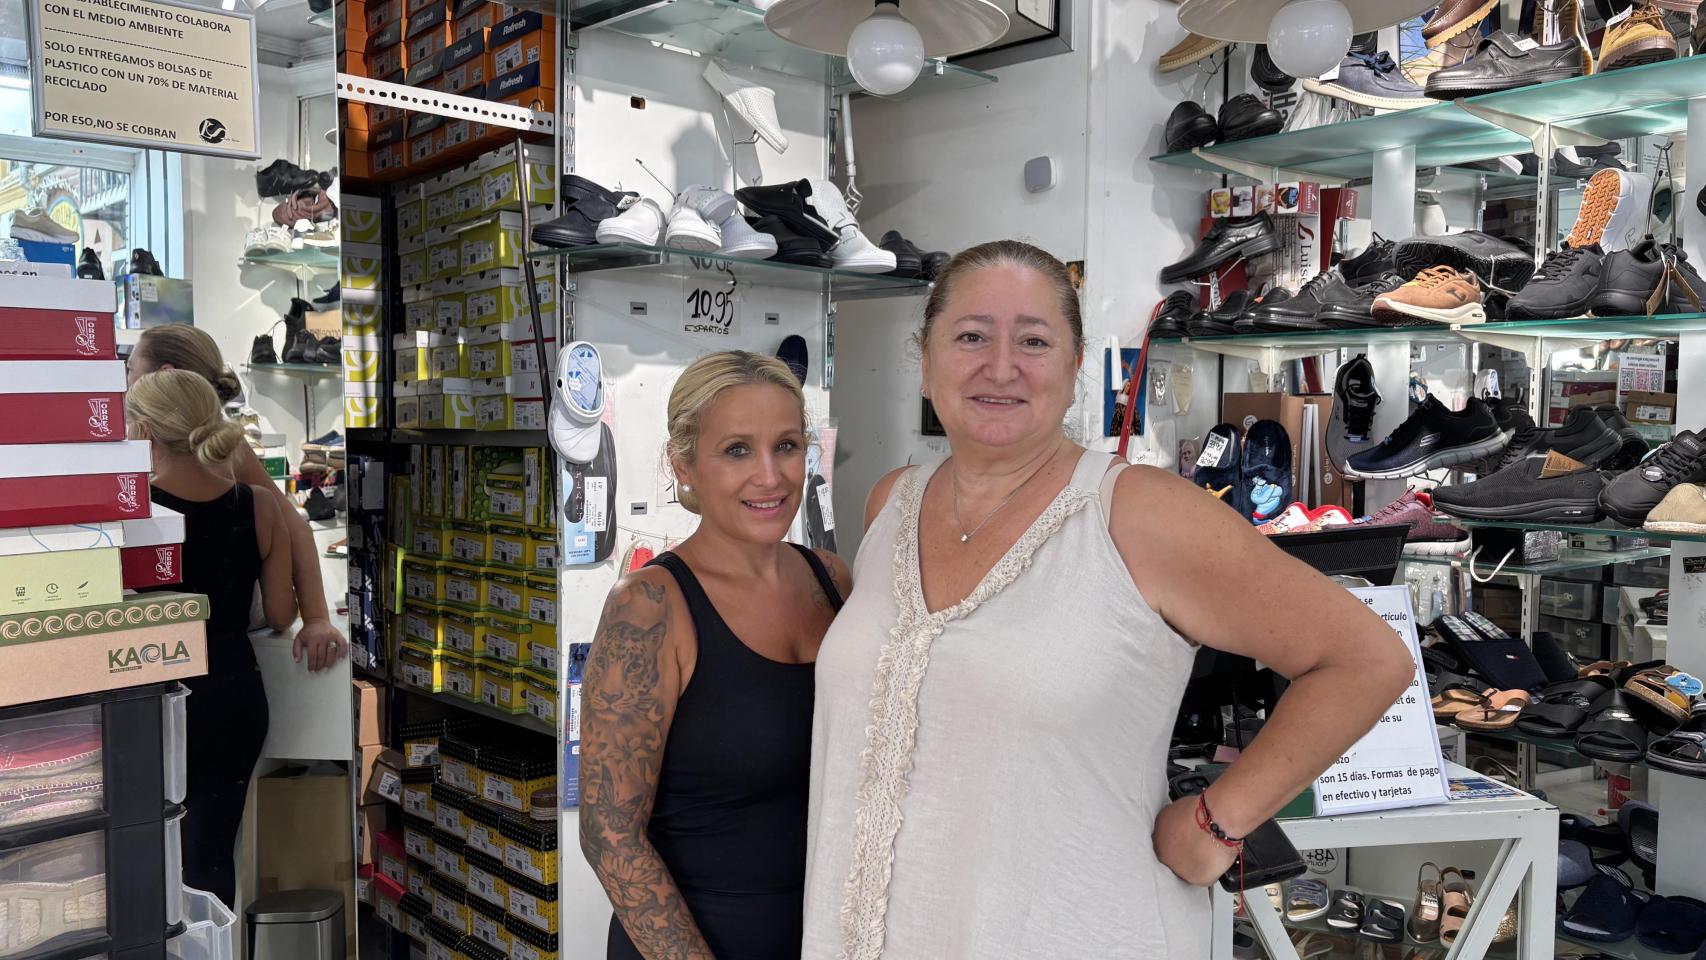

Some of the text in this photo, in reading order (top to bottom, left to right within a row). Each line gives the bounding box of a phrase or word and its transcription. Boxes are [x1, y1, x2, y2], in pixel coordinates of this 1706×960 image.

[44, 3, 184, 39] CON EL MEDIO AMBIENTE
[77, 0, 232, 33] ABLECIMIENTO COLABORA
[502, 18, 527, 36] Refresh
[44, 40, 213, 80] SOLO ENTREGAMOS BOLSAS DE
[44, 58, 239, 101] PLASTICO CON UN 70% DE MATERIAL
[44, 75, 108, 93] RECICLADO
[499, 74, 524, 90] Refresh
[44, 111, 69, 123] POR
[116, 121, 129, 132] SE
[131, 124, 176, 139] COBRAN
[687, 288, 735, 327] 10.95
[684, 324, 729, 335] ESPARTOS
[1364, 597, 1373, 605] se
[107, 639, 191, 669] KAOLA
[1405, 694, 1416, 704] de
[1392, 714, 1402, 723] su
[1319, 766, 1440, 784] son 15 días. Formas de pago
[1322, 786, 1412, 802] en efectivo y tarjetas
